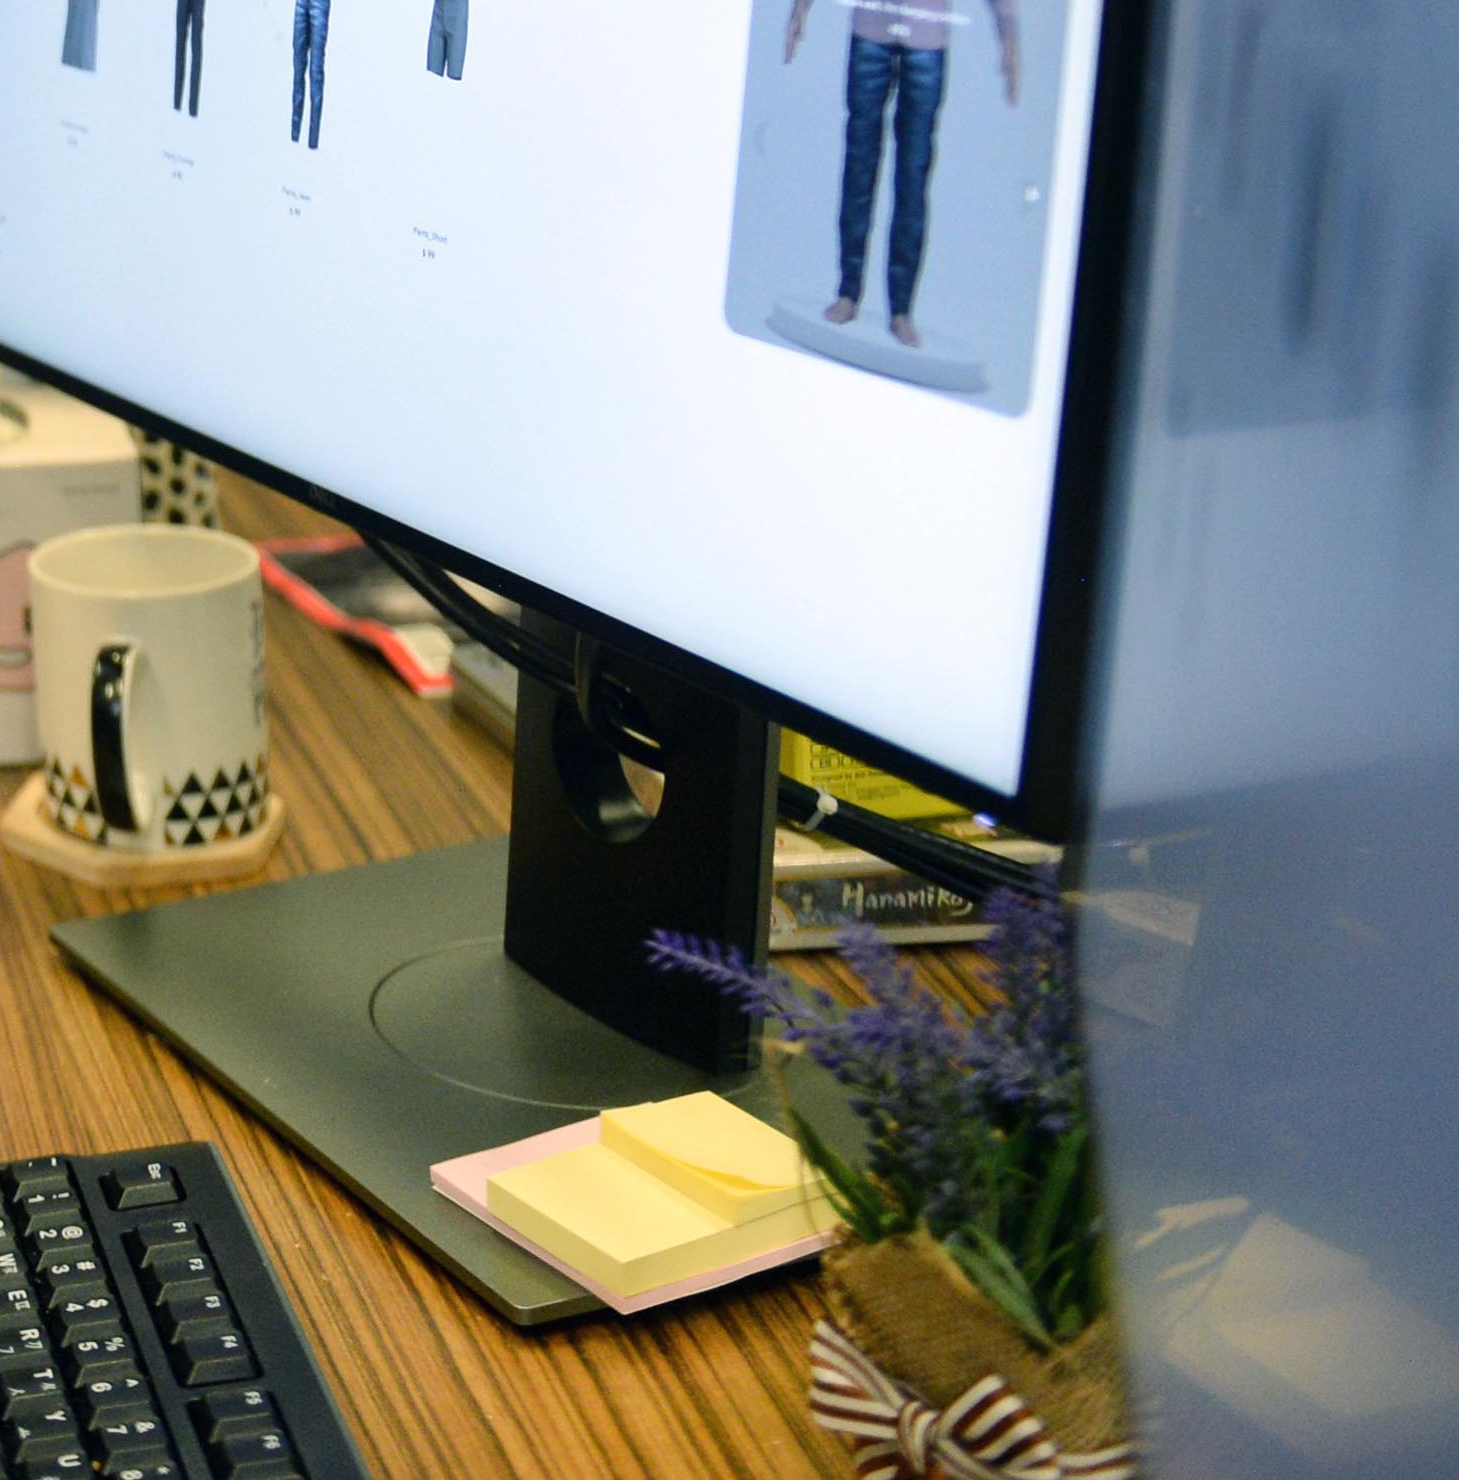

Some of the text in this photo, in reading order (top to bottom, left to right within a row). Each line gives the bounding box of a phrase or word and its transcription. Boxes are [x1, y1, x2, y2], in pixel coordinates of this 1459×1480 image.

[28, 1194, 45, 1203] 1
[62, 1226, 83, 1239] @
[172, 1222, 187, 1234] F1
[39, 1229, 57, 1240] 2
[51, 1264, 70, 1275] 3
[189, 1258, 204, 1270] F2
[8, 1289, 27, 1301] E
[66, 1303, 84, 1313] 4
[205, 1296, 220, 1309] F3
[20, 1328, 39, 1340] R
[78, 1341, 98, 1352] 5
[105, 1337, 125, 1351] %
[221, 1335, 238, 1348] F4
[33, 1368, 53, 1379] T
[91, 1382, 112, 1393] 6
[45, 1410, 66, 1421] Y
[107, 1424, 128, 1435] 7
[58, 1454, 81, 1467] U
[120, 1469, 143, 1480] 8
